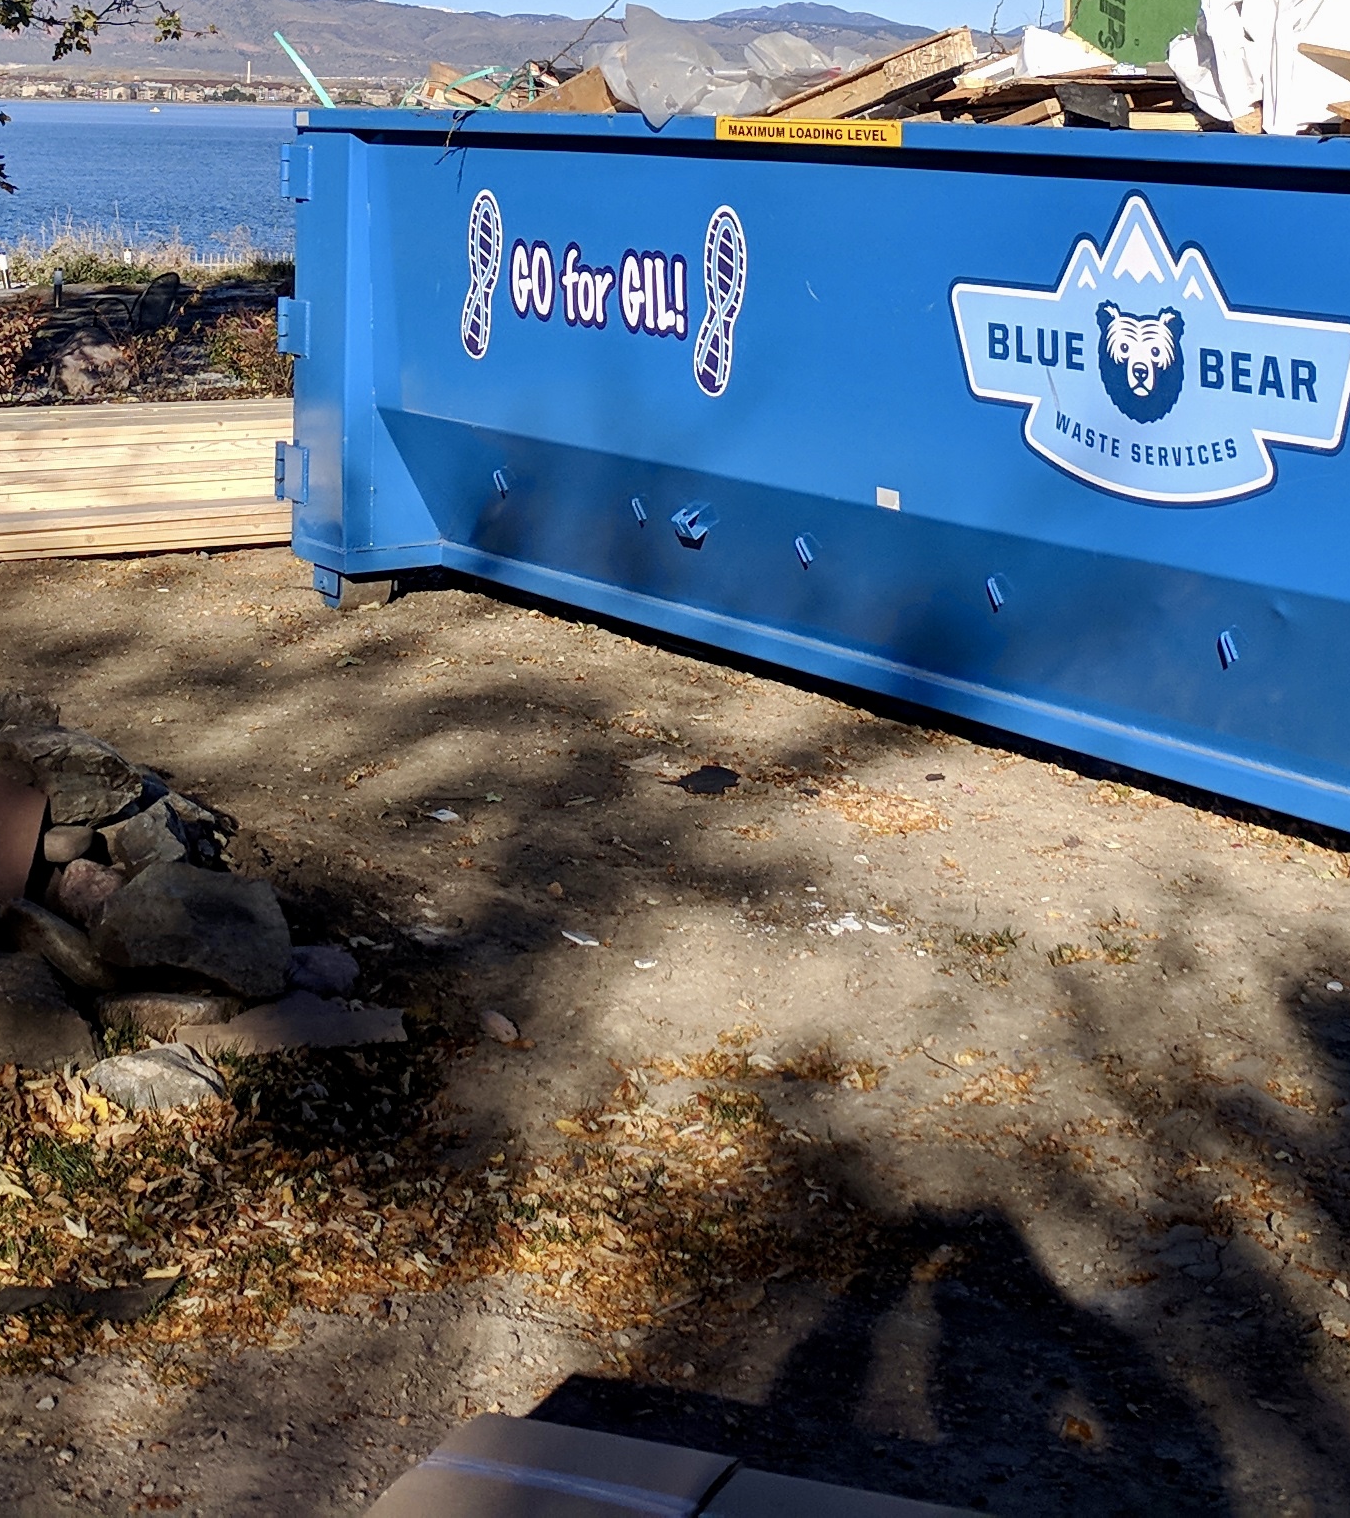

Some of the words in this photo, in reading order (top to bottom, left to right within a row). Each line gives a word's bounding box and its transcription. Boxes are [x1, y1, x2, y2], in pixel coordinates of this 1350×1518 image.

[728, 124, 785, 138] MAXIMUM
[789, 126, 843, 140] LOADING
[847, 128, 887, 142] LEVEL
[511, 244, 554, 316] GO
[561, 247, 613, 323] for
[621, 254, 685, 334] GIL!
[987, 322, 1085, 371] BLUE
[1198, 348, 1318, 403] BEAR
[1055, 410, 1121, 458] WASTE
[1130, 437, 1238, 468] SERVICES
